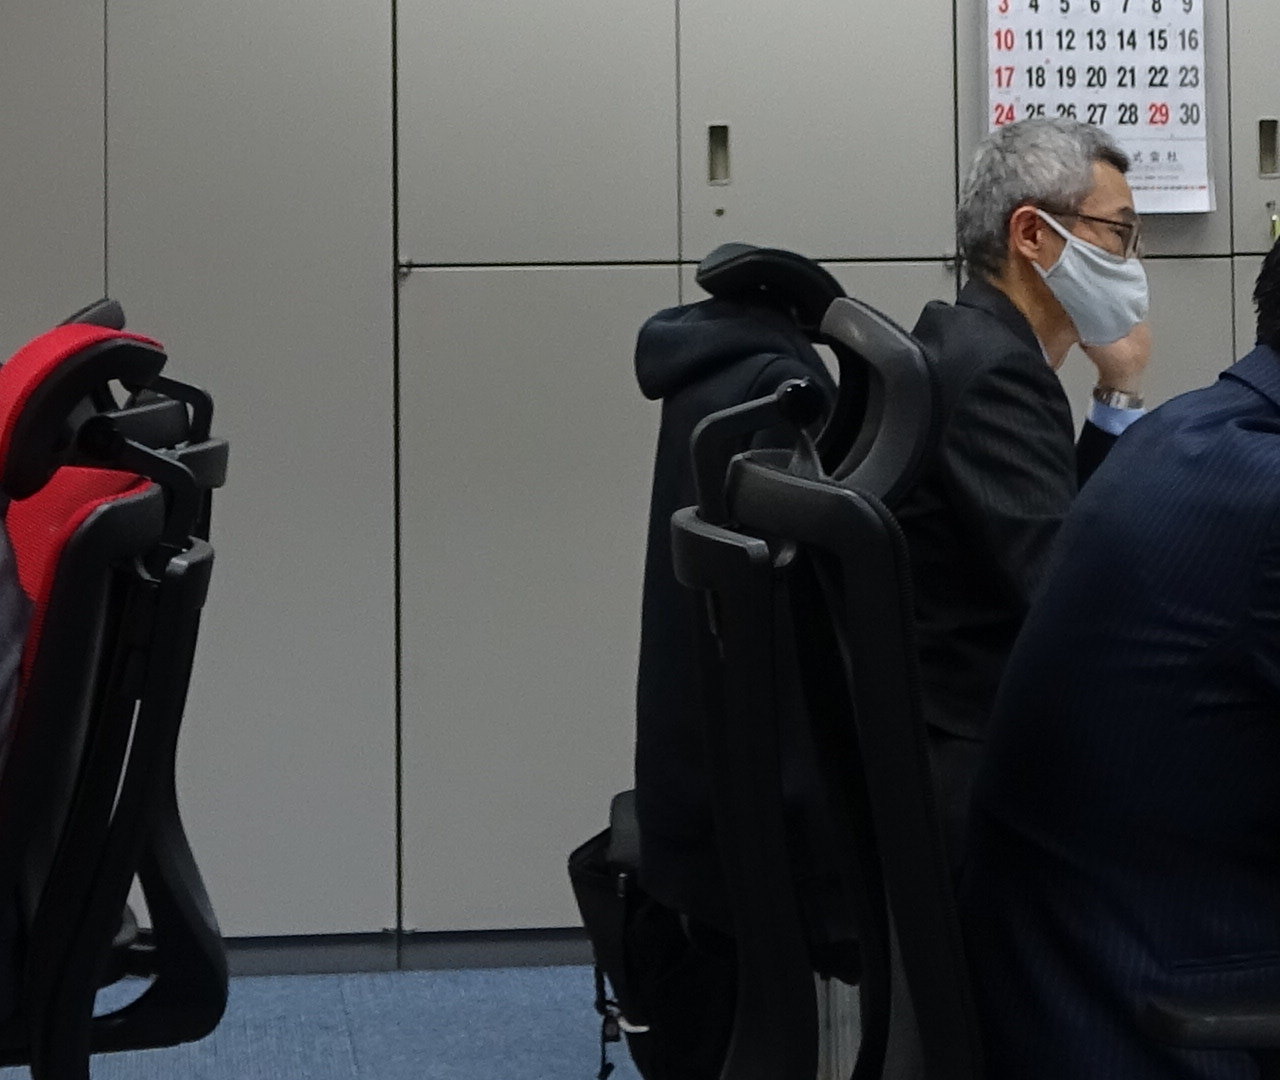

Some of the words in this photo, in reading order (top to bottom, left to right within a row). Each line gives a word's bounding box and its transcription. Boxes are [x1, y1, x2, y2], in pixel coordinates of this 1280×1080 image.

[995, 29, 1014, 51] 10
[1026, 30, 1042, 50] 11
[1057, 29, 1075, 50] 12
[1087, 29, 1106, 50] 13
[1118, 29, 1136, 50] 14
[1148, 29, 1167, 50] 15
[1179, 29, 1198, 50] 16
[996, 67, 1014, 88] 17
[1027, 67, 1045, 87] 18
[1057, 67, 1075, 87] 19
[1087, 67, 1106, 87] 20
[1117, 66, 1135, 87] 21
[1149, 66, 1168, 87] 22
[1179, 66, 1199, 88] 23
[995, 104, 1016, 125] 24
[1087, 104, 1107, 125] 27
[1118, 104, 1138, 125] 28
[1149, 104, 1169, 125] 29
[1180, 103, 1200, 125] 30
